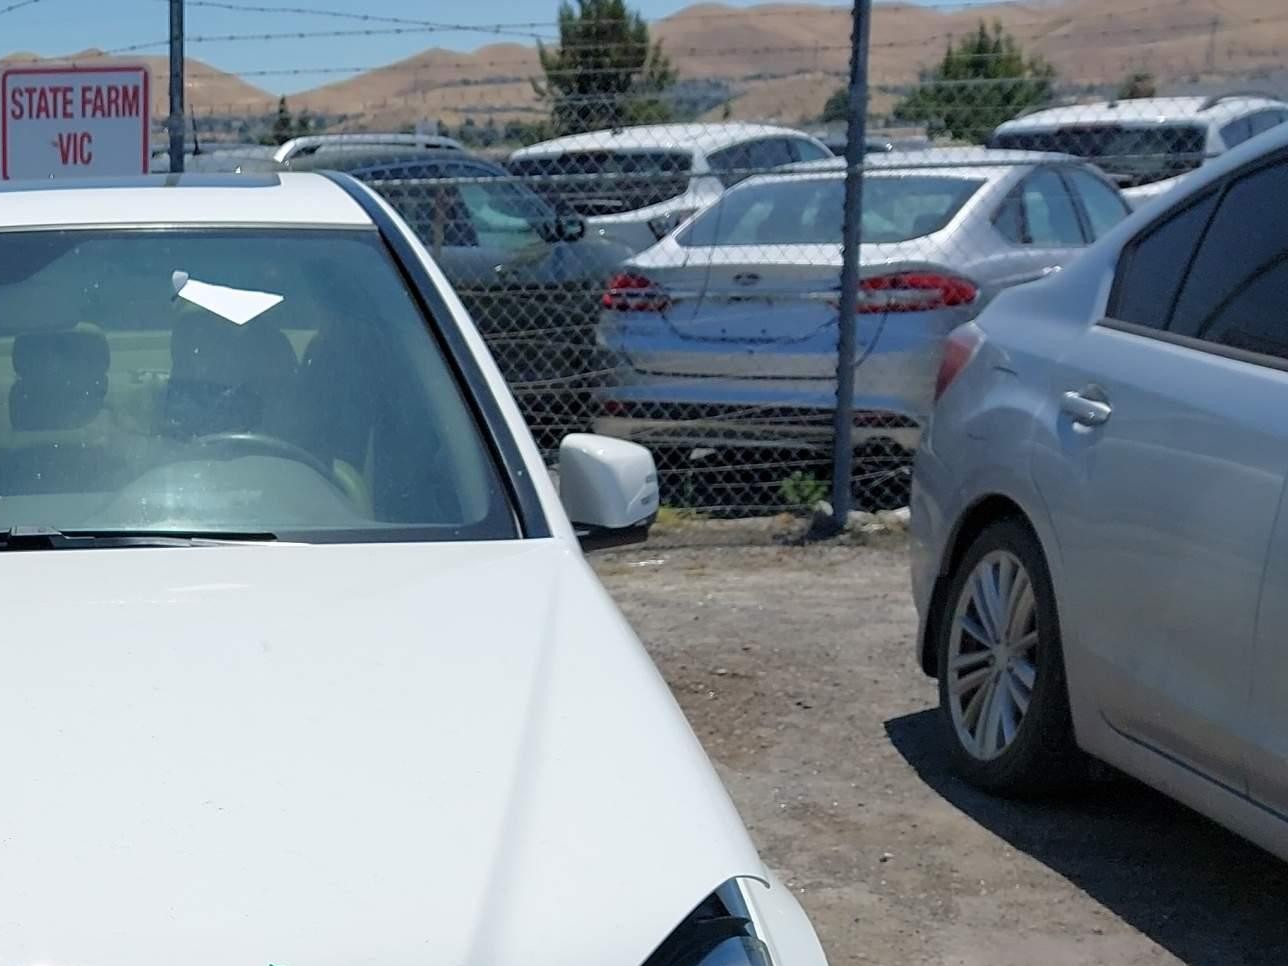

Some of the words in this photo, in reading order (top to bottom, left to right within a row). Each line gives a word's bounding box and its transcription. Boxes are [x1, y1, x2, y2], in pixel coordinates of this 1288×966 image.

[11, 86, 74, 120] STATE
[81, 84, 140, 118] FARM
[58, 132, 93, 166] VIC
